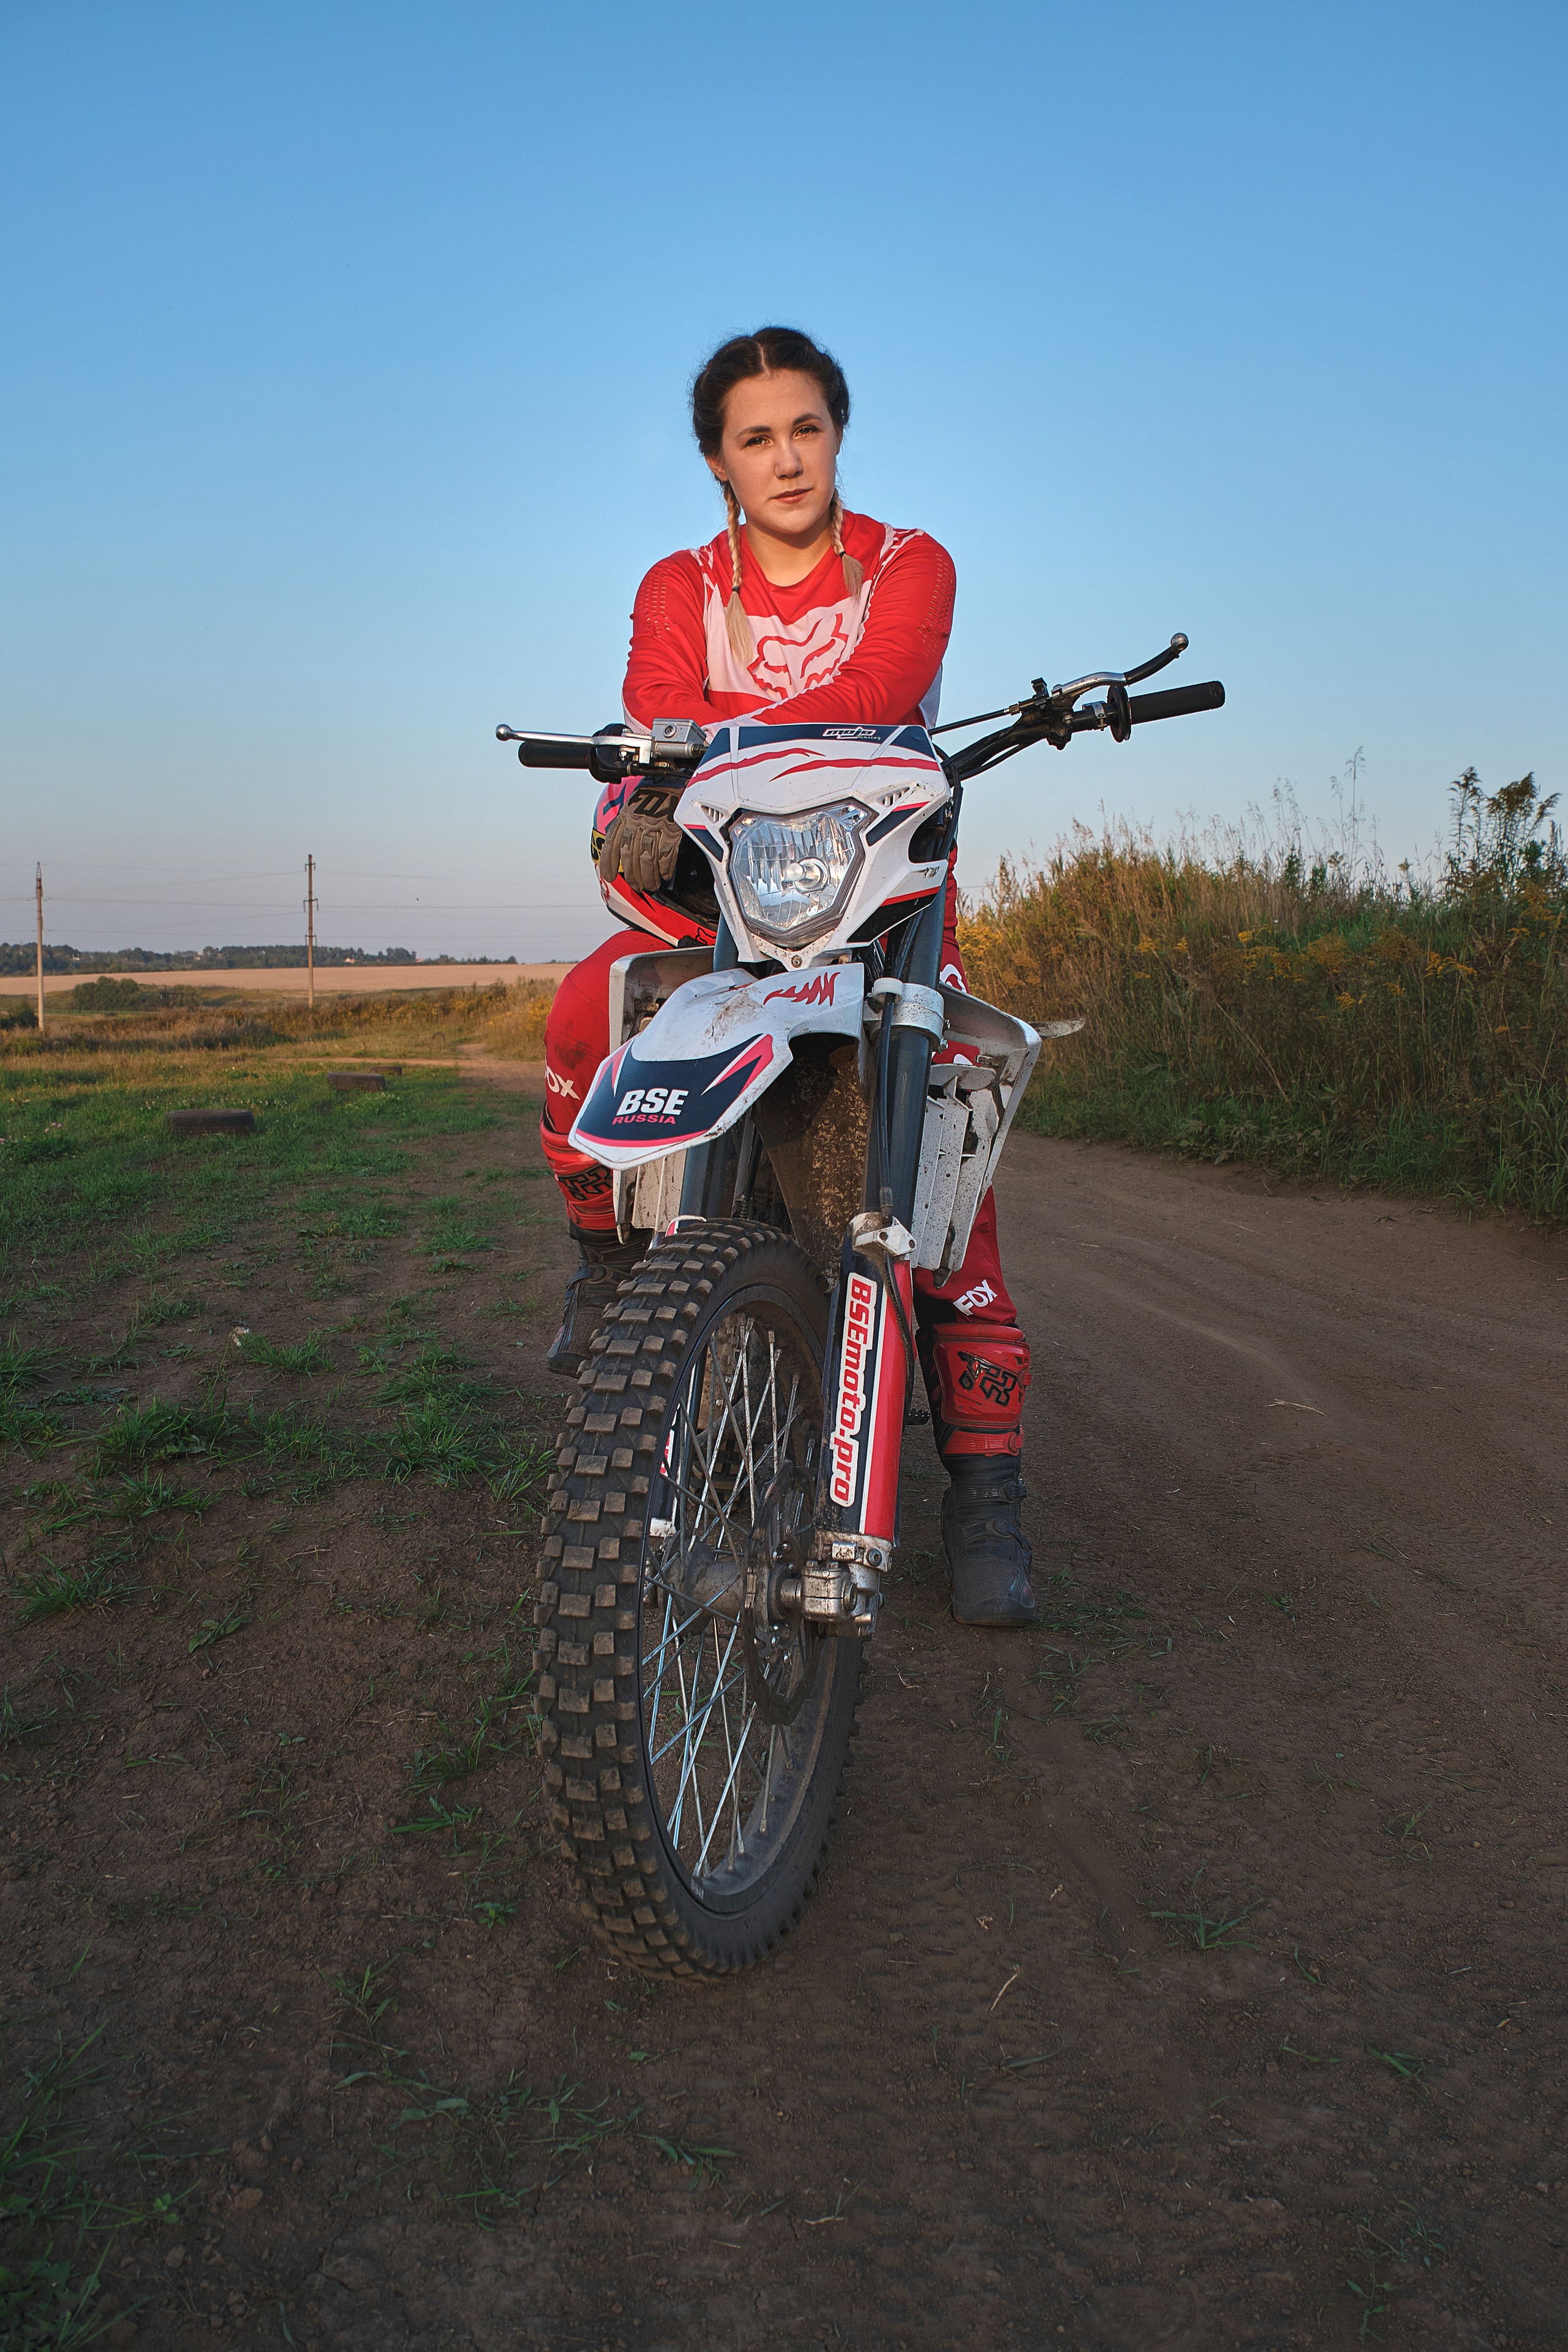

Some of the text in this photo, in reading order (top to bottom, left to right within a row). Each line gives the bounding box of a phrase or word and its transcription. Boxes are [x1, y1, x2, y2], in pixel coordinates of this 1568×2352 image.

[545, 1058, 581, 1101] OX
[612, 1114, 676, 1125] RUSSIA
[616, 1088, 689, 1116] BSE
[952, 1279, 998, 1316] FOX
[834, 1278, 872, 1502] BSEmoto.pro
